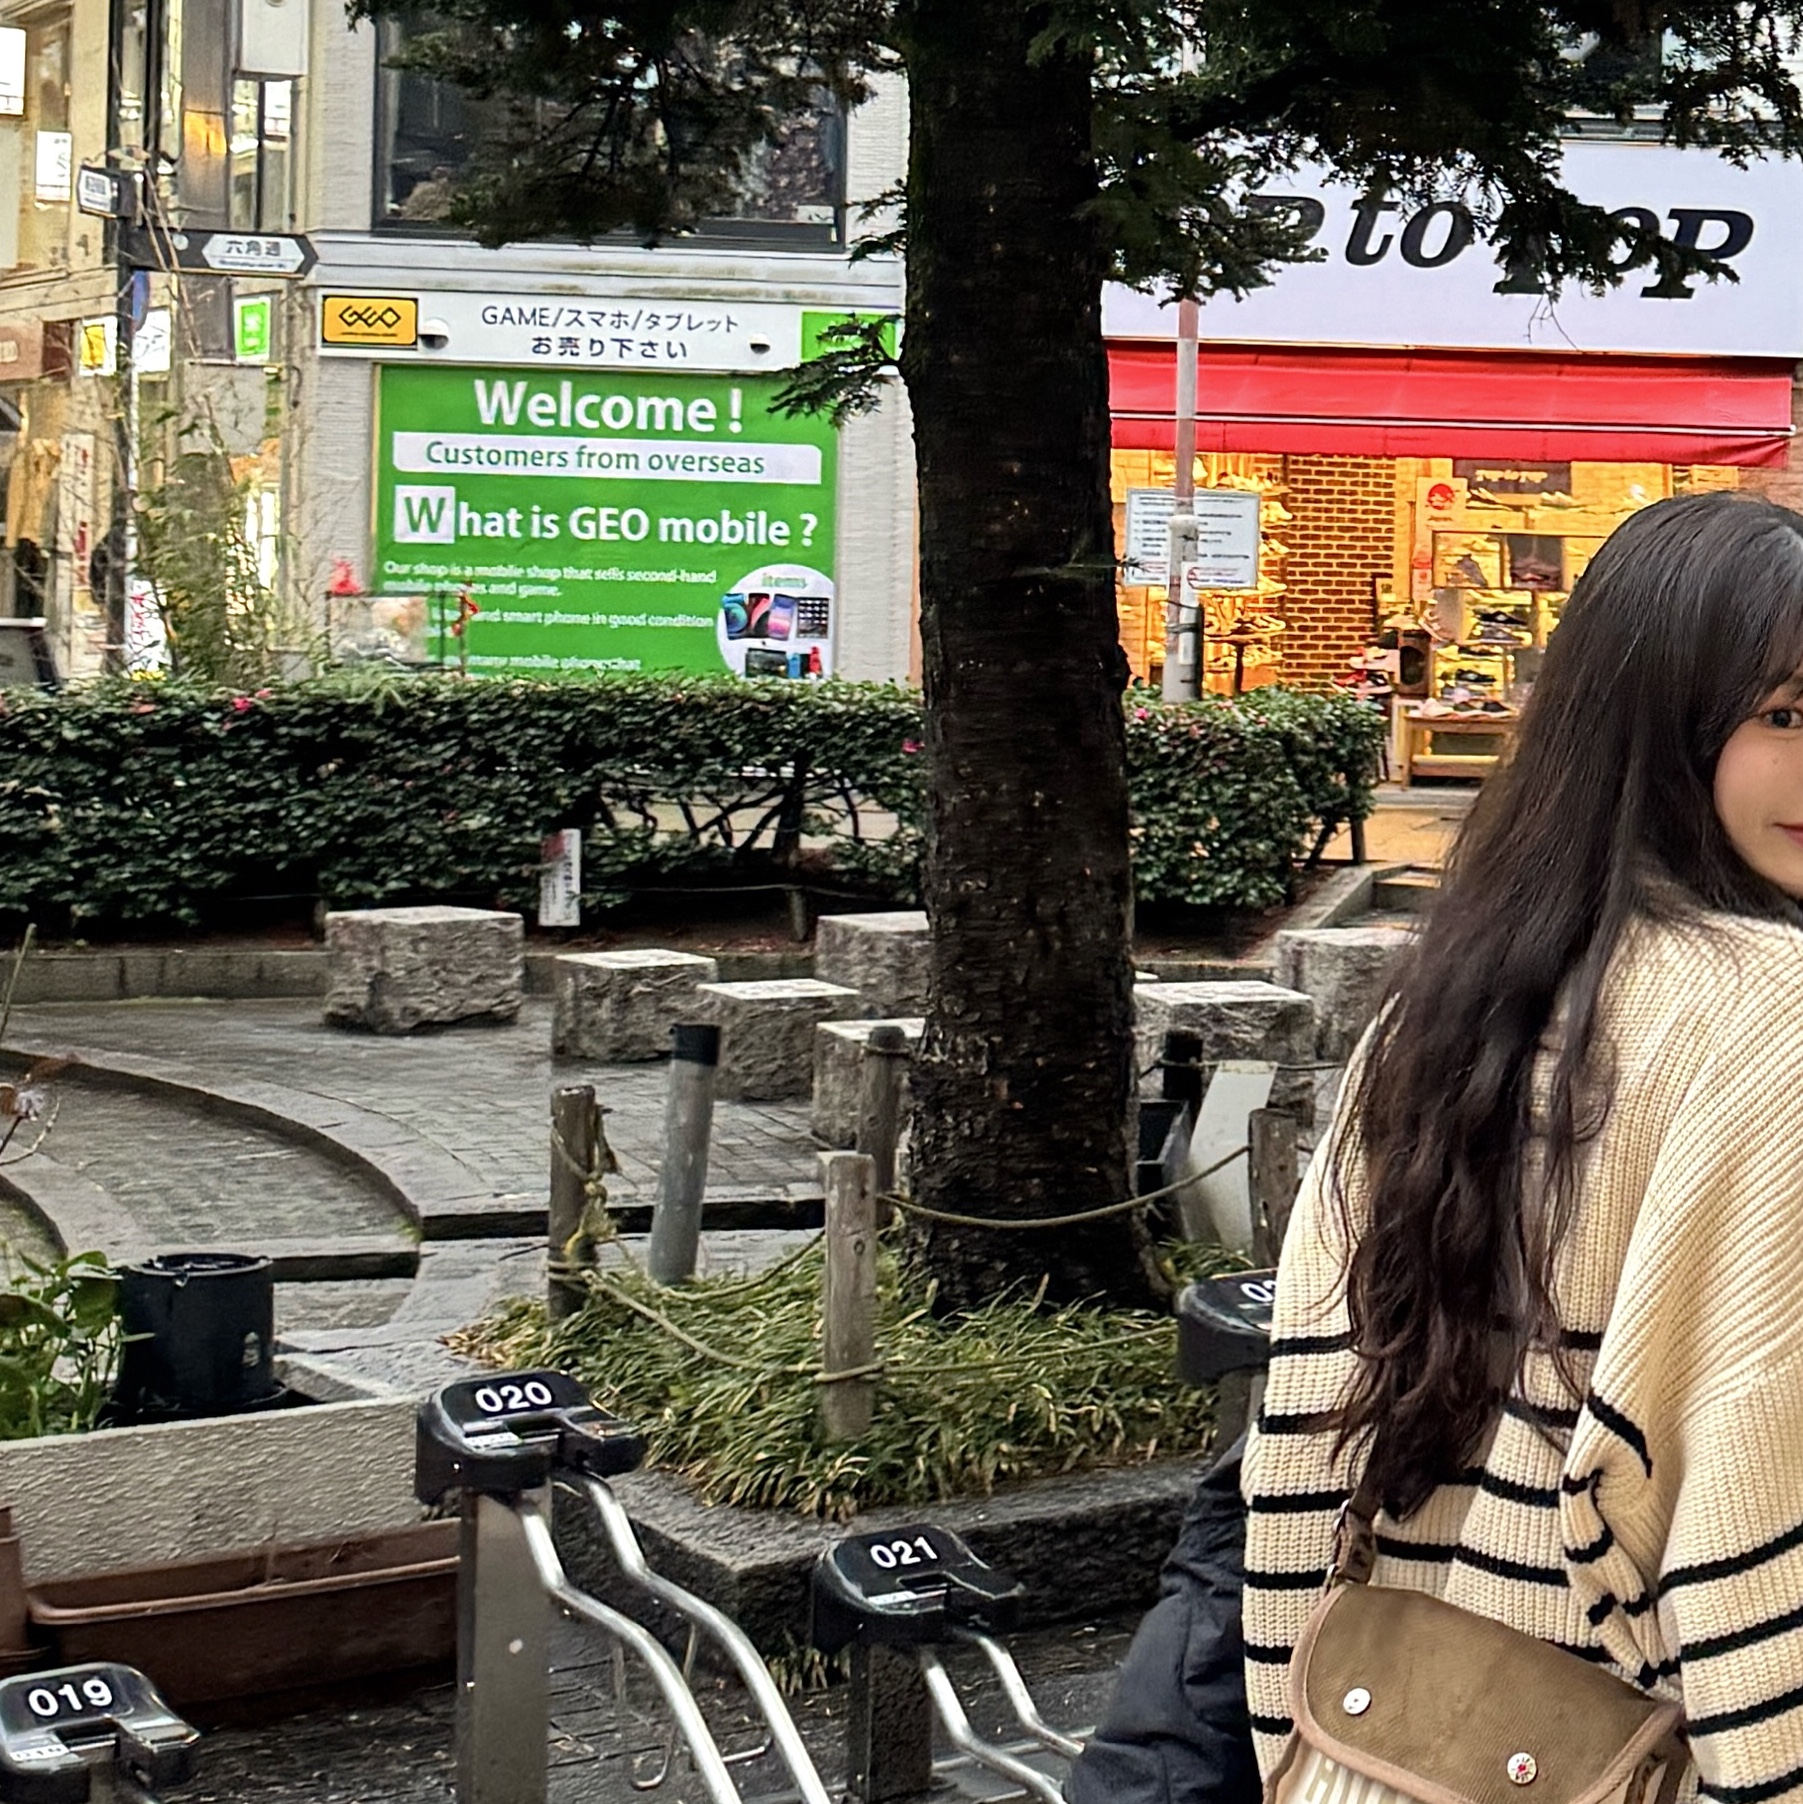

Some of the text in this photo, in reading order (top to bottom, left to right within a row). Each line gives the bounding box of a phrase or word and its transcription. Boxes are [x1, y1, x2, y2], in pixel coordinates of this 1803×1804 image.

[339, 306, 402, 329] GEO
[482, 306, 739, 333] GAME/スマホ/タブレット
[532, 336, 688, 359] お売り下さい
[473, 379, 717, 432] Welcome
[425, 440, 765, 474] Customers from overseas
[404, 496, 818, 547] What is GEO mobile ?
[475, 1381, 552, 1413] 020
[869, 1536, 938, 1569] 021
[28, 1679, 113, 1716] 019
